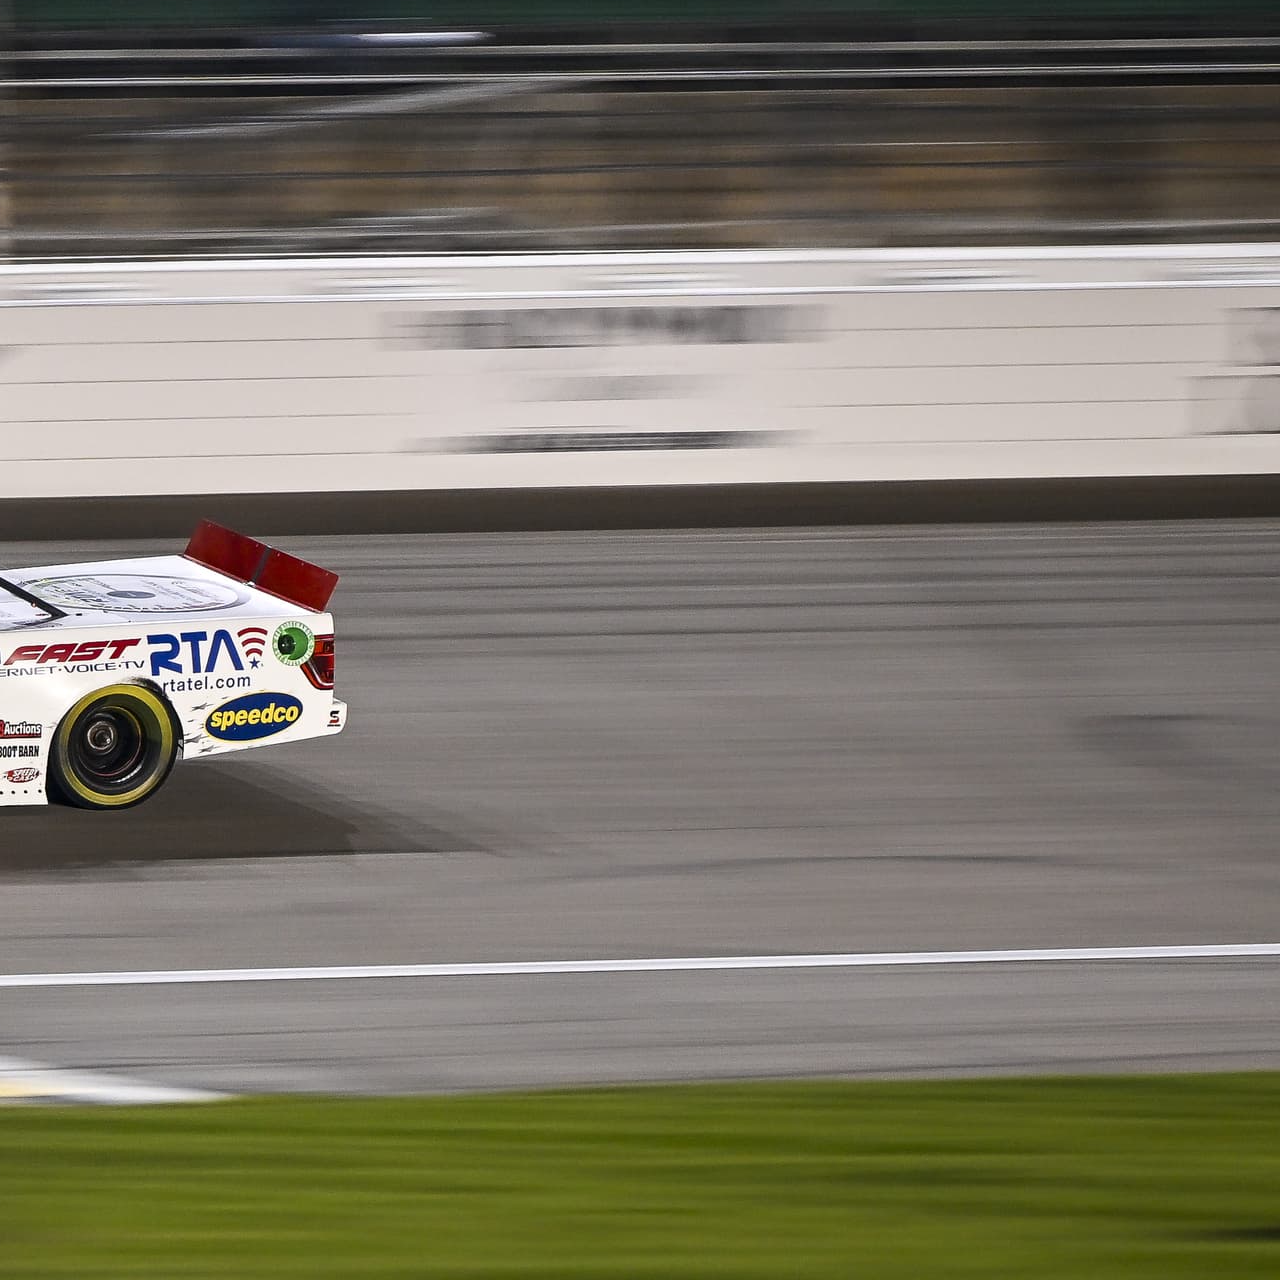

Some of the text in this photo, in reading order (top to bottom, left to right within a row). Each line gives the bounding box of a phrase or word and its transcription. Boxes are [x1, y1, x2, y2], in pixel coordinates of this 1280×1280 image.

[3, 638, 142, 666] FAST
[147, 629, 245, 676] RTA
[163, 675, 251, 692] rtatel.com
[210, 702, 299, 731] speedco
[19, 745, 40, 757] BARN
